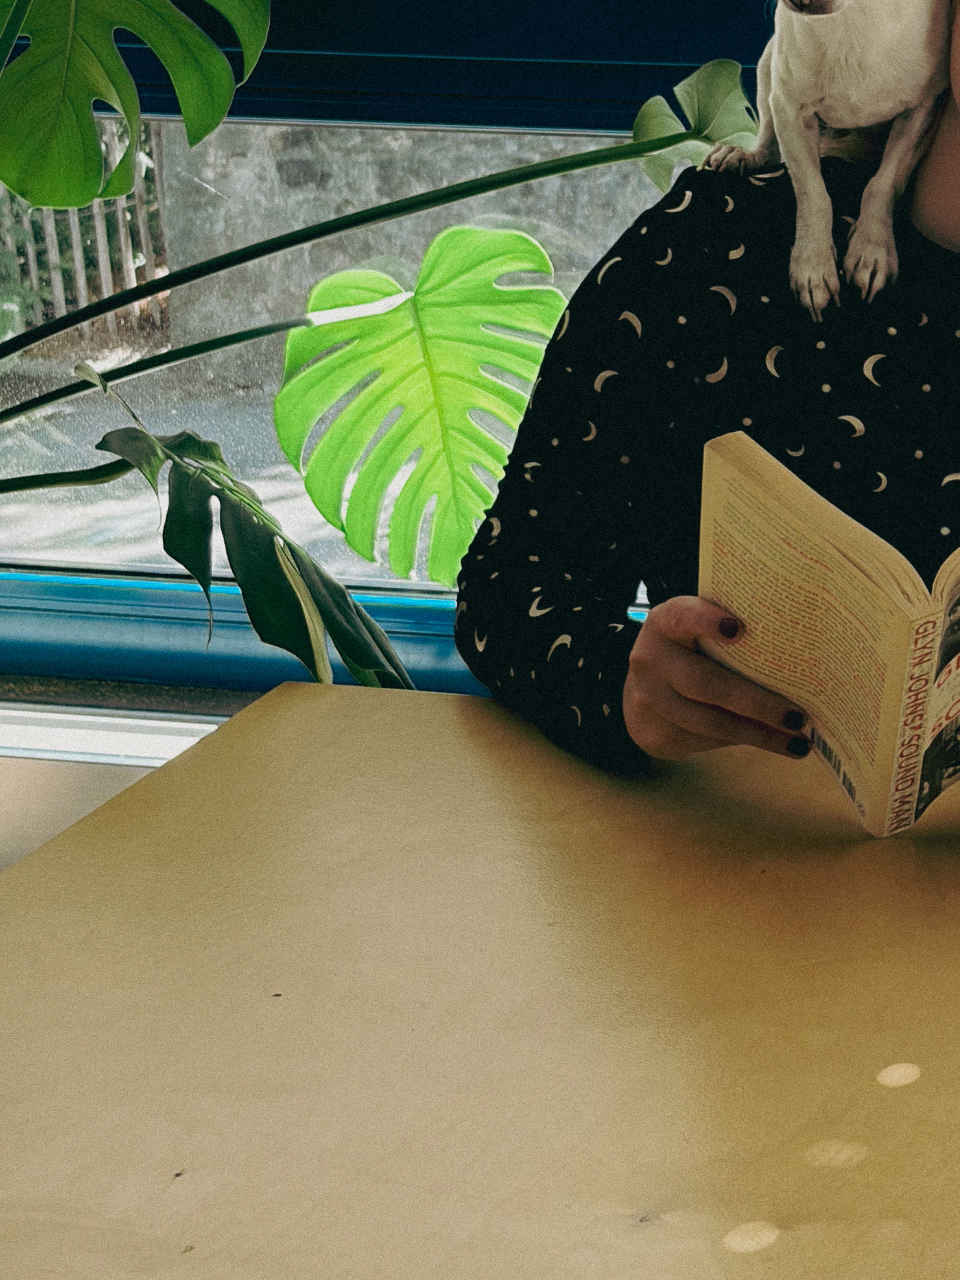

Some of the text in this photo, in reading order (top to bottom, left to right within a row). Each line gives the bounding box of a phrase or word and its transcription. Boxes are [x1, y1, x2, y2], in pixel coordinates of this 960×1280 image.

[888, 620, 937, 836] GLYN JOHNS SOUND MAN
